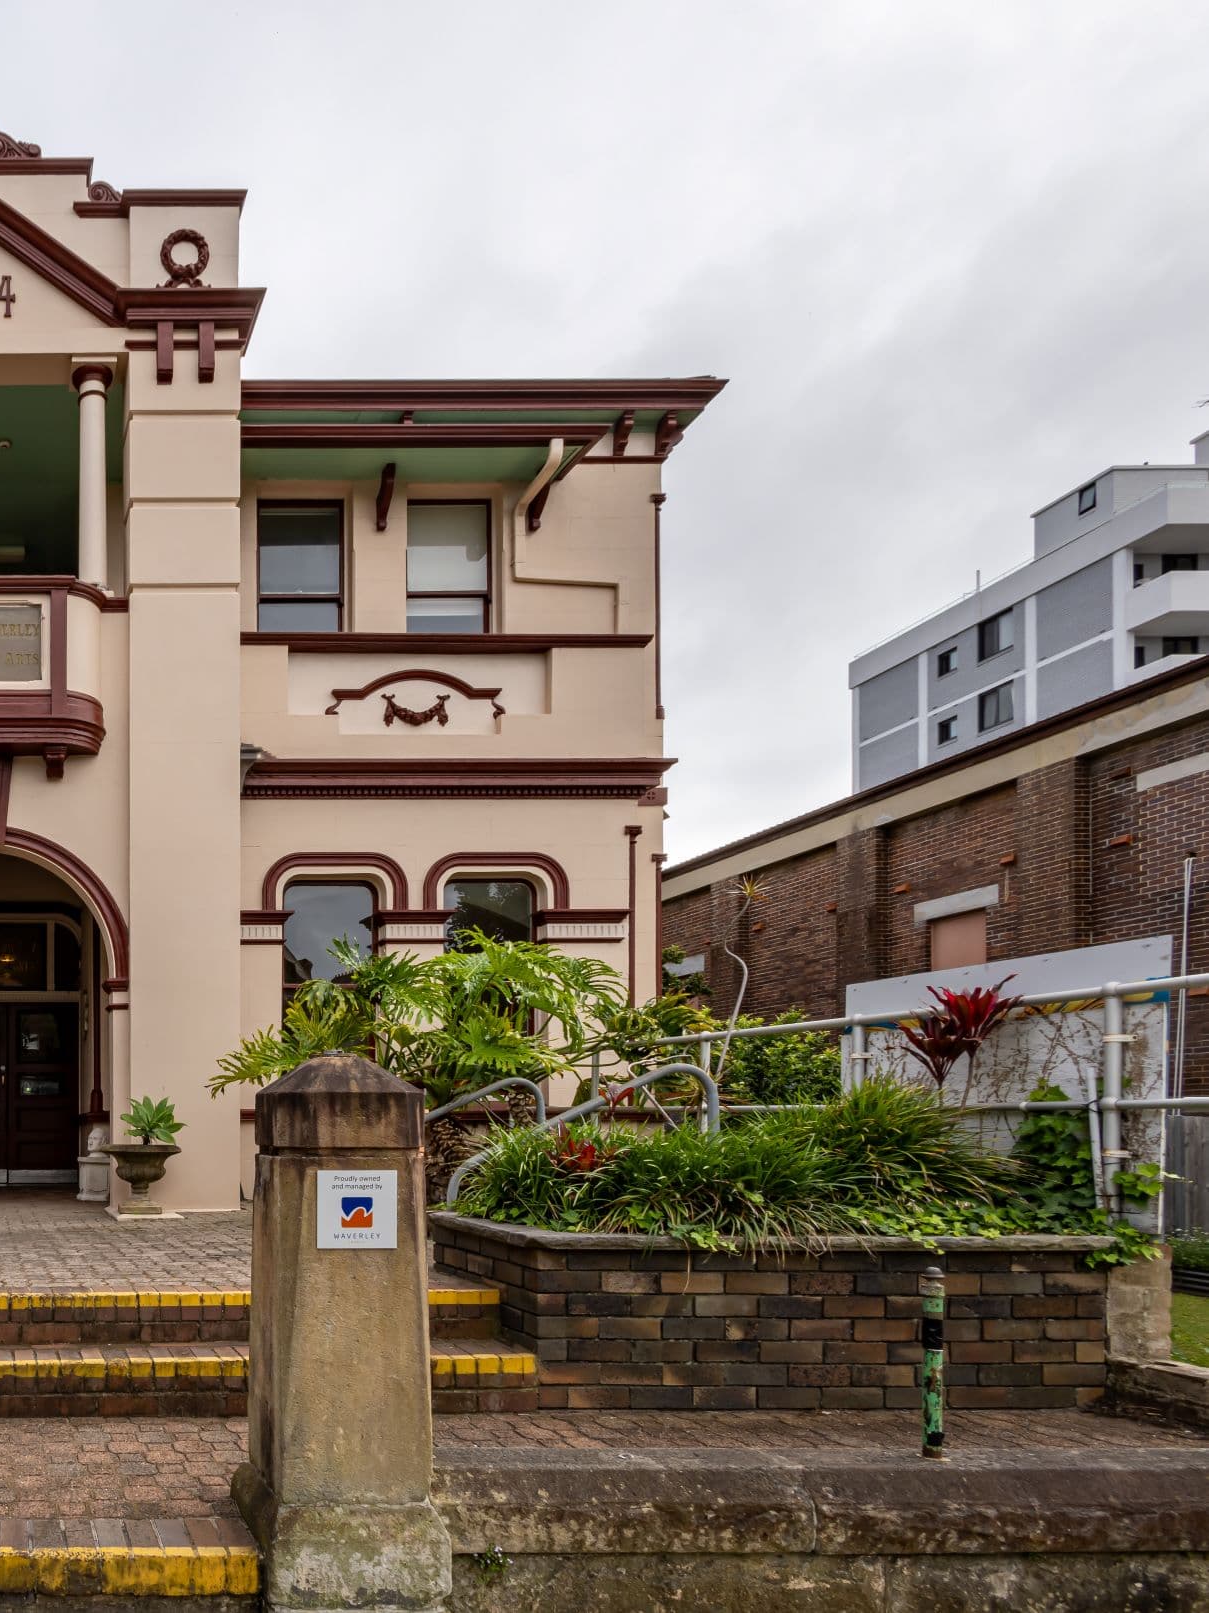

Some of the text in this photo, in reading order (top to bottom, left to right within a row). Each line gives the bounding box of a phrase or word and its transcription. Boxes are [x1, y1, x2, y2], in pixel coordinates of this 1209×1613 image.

[5, 652, 39, 665] ARTS
[333, 1175, 357, 1183] Proudly
[345, 1183, 373, 1191] managed
[333, 1232, 381, 1240] WAVERLEY
